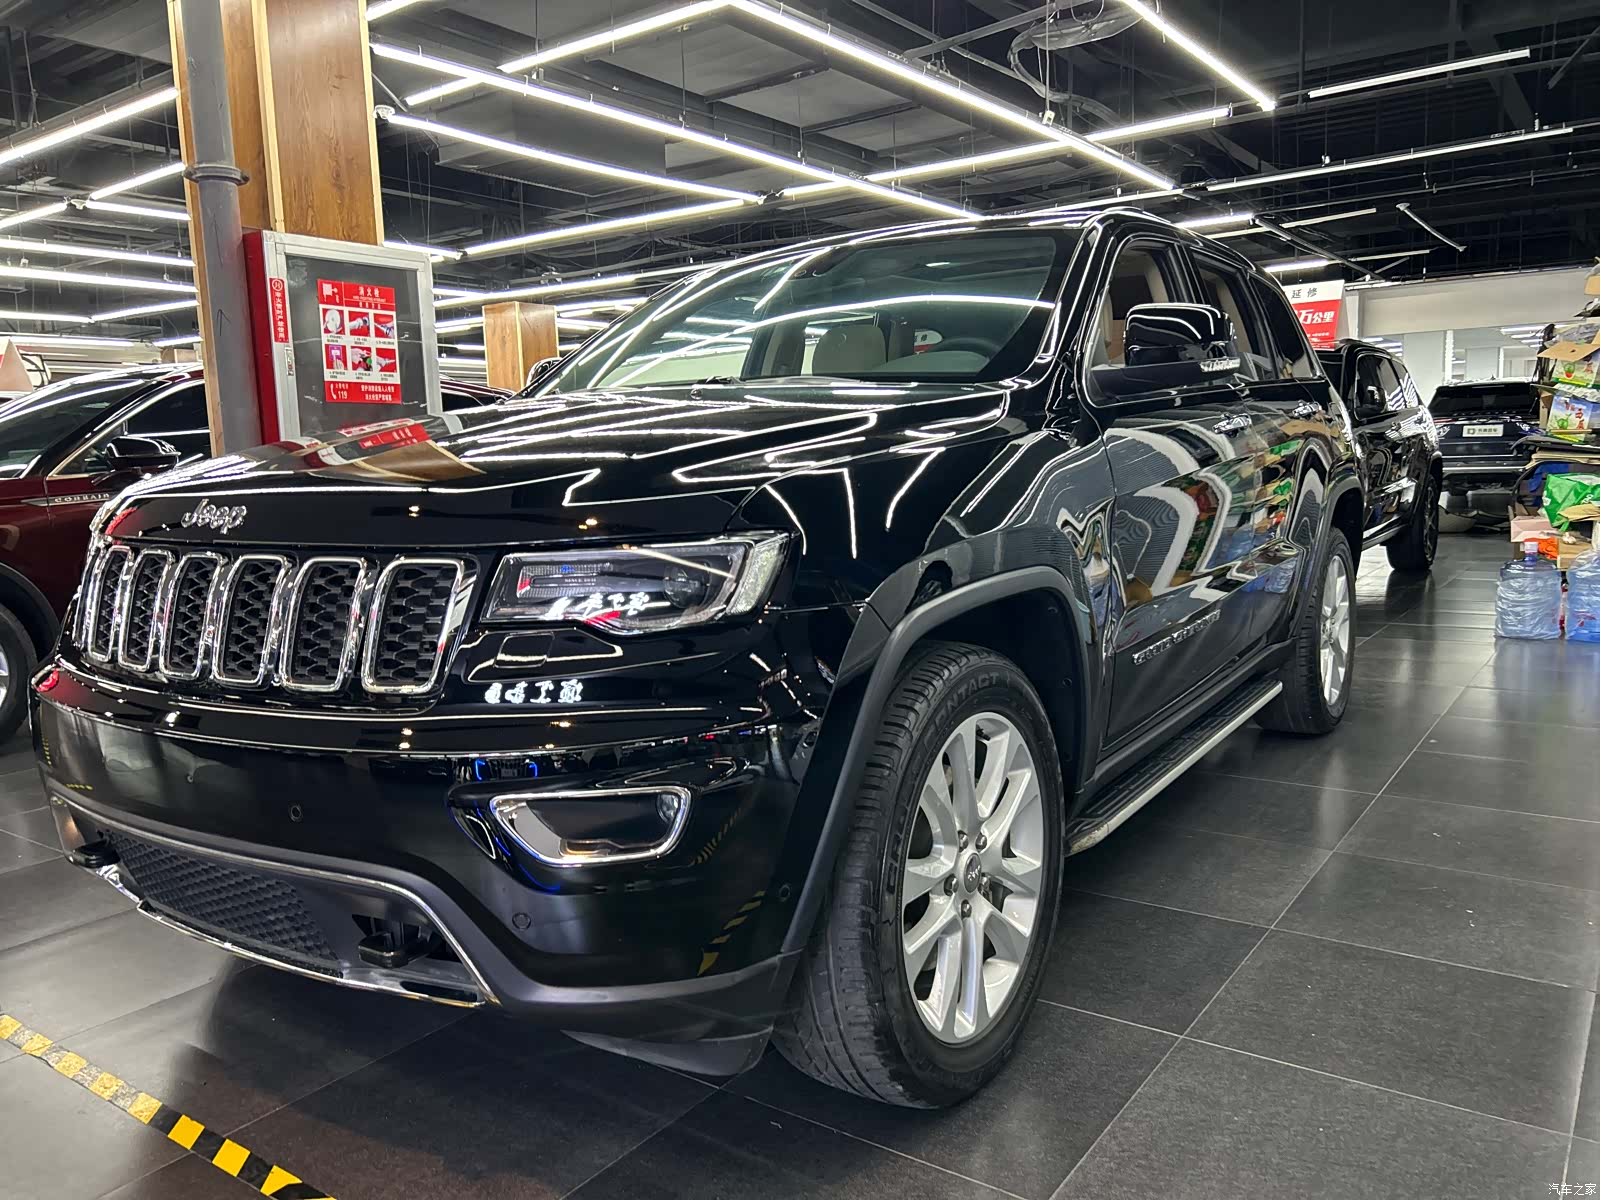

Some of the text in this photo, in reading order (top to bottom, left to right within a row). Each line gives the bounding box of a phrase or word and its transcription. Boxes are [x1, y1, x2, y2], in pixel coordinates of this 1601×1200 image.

[1291, 287, 1318, 300] 延修
[1295, 308, 1335, 325] 万公里
[337, 390, 348, 400] 119
[181, 498, 247, 535] Jeep
